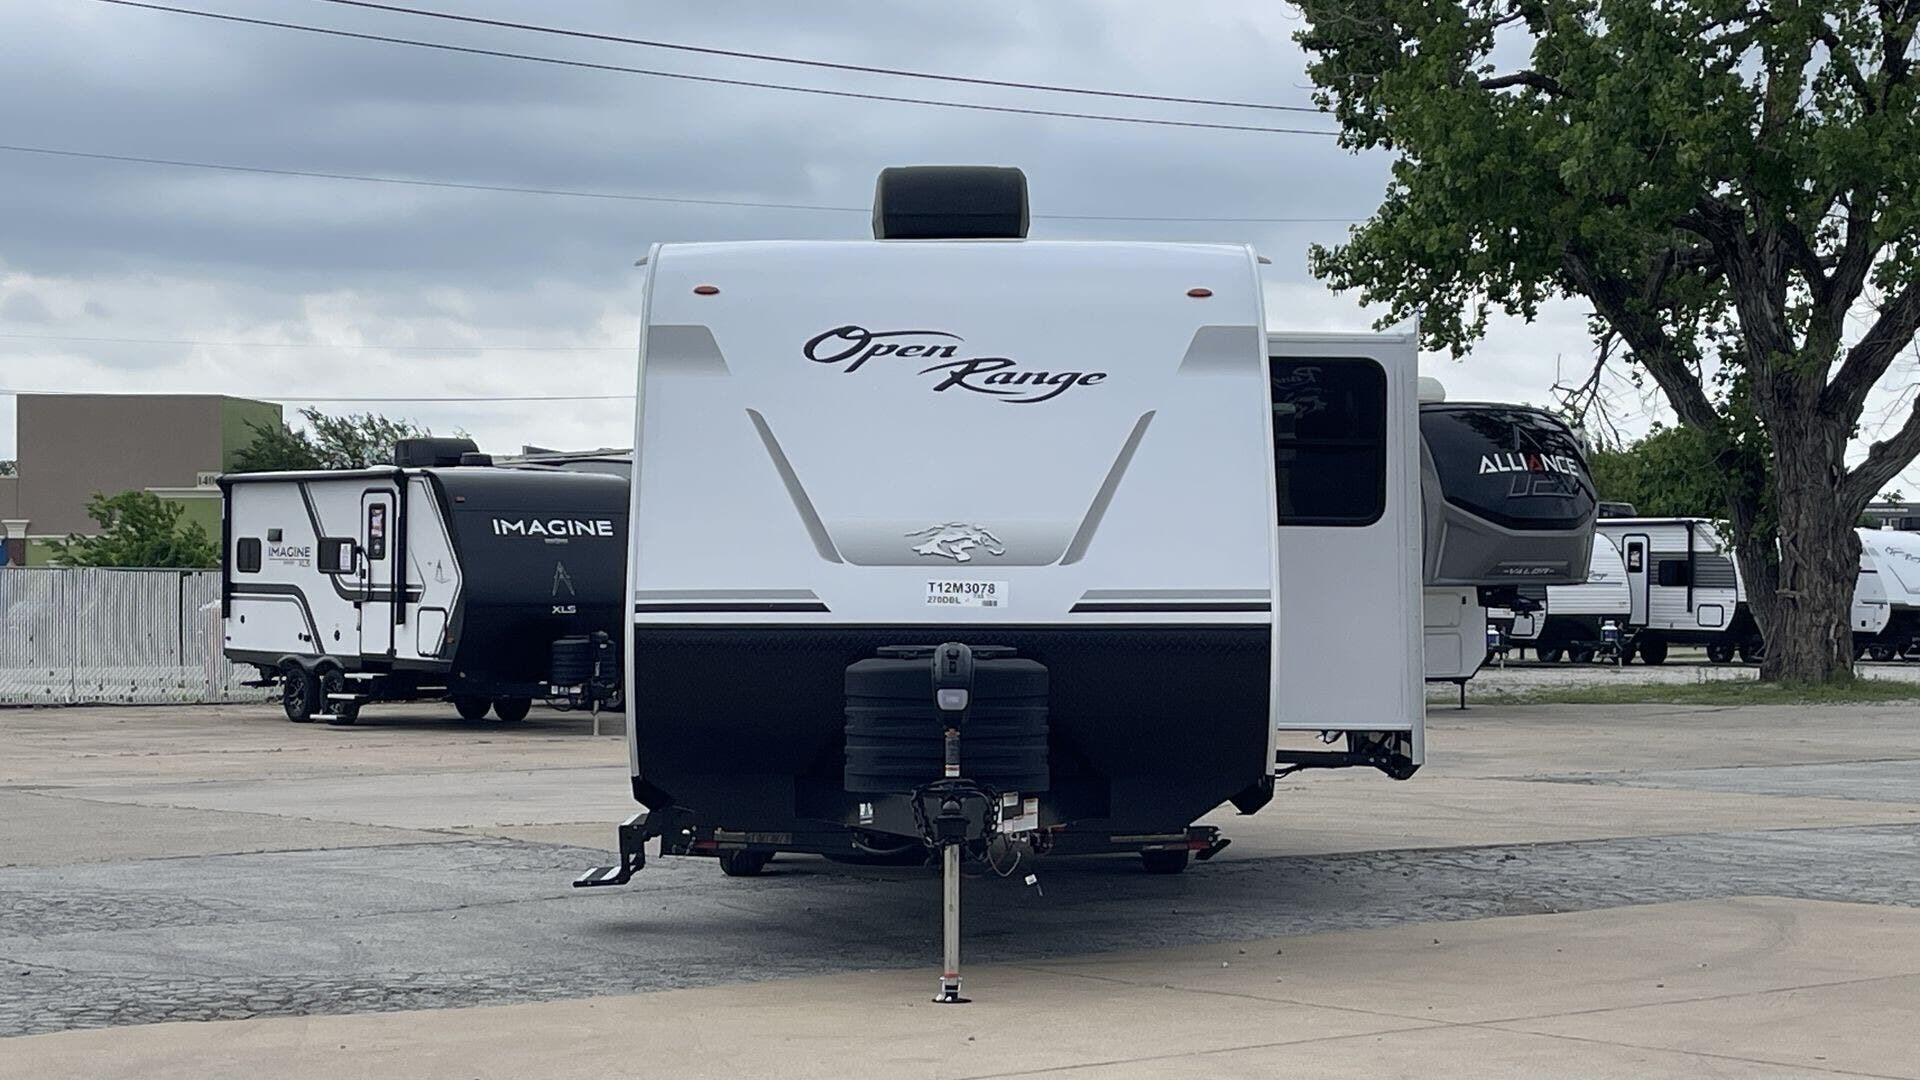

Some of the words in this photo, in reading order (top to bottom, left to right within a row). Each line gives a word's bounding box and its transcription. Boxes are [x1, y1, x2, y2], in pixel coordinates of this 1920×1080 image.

[803, 324, 965, 374] Open
[917, 357, 1107, 404] Range
[1478, 452, 1579, 475] ALLIANCE
[492, 519, 614, 536] IMAGINE
[268, 546, 311, 557] IMAGINE
[927, 582, 996, 595] T12M3078
[552, 605, 577, 614] XLS
